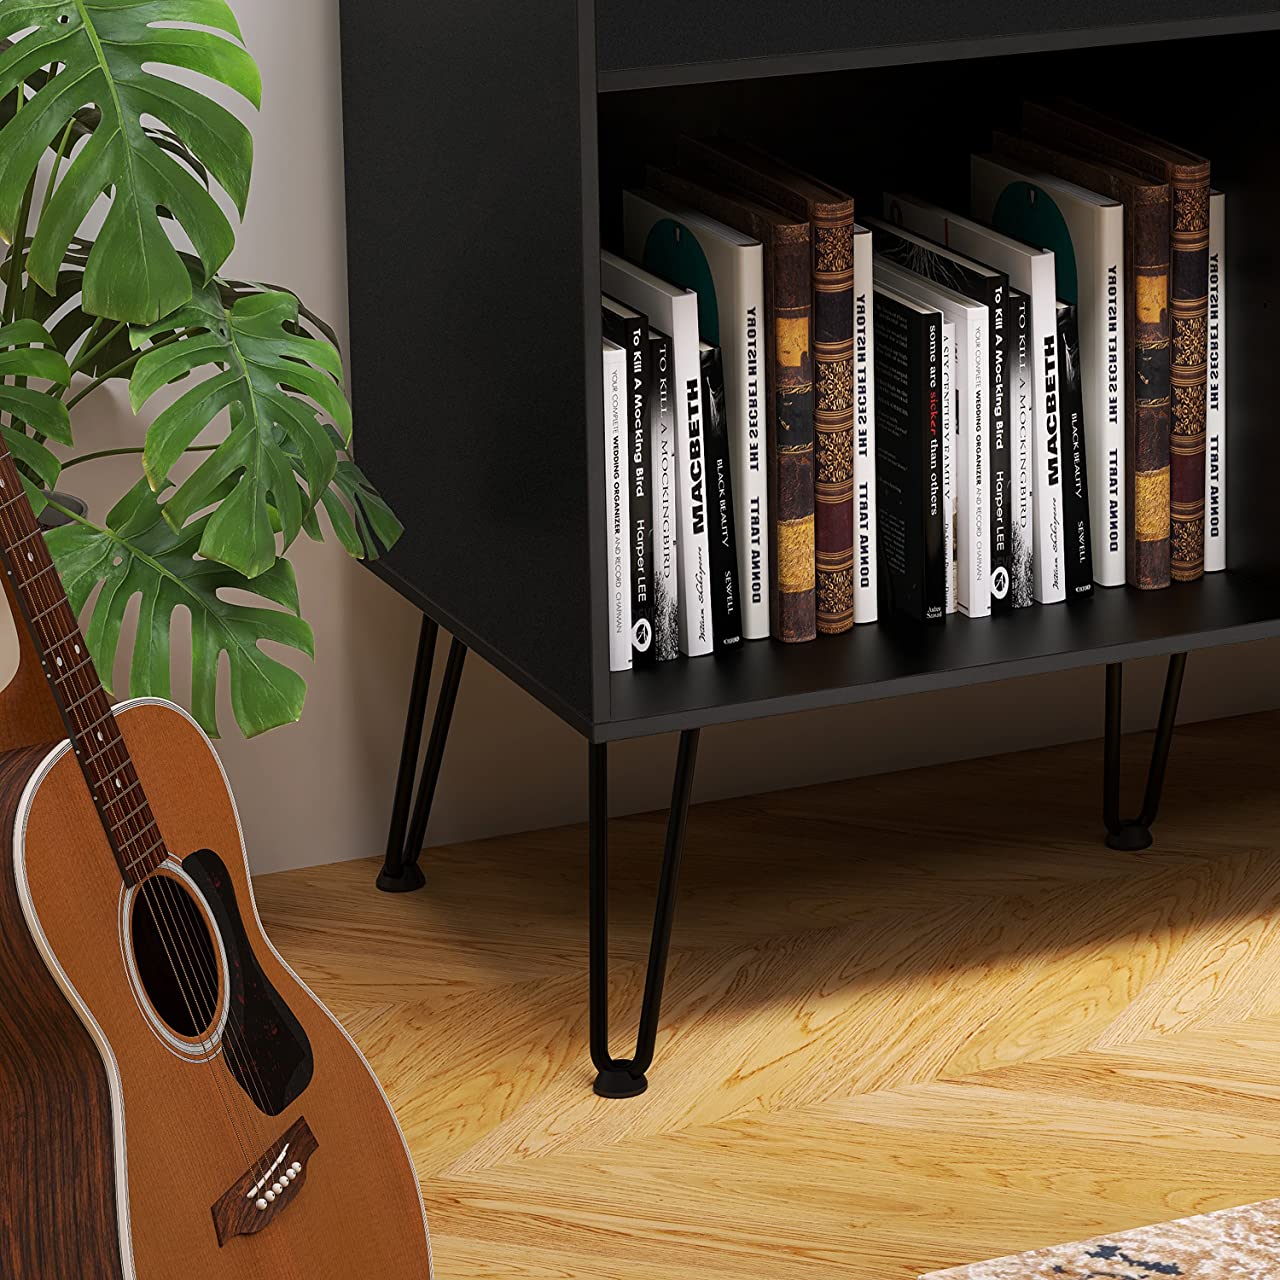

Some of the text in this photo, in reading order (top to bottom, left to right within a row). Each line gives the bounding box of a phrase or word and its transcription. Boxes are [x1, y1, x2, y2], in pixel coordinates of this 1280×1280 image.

[632, 328, 641, 347] To
[633, 350, 642, 373] Kill
[974, 351, 982, 389] COMPLETE
[634, 378, 643, 391] A
[611, 394, 620, 434] COMPLETE
[633, 394, 644, 463] Mocking
[930, 390, 939, 436] sicker
[994, 286, 1005, 552] To Kill A Mocking Bird Harper LEE
[1018, 301, 1028, 529] TO KILL A MOCKINGBIRD
[1043, 335, 1060, 487] MACBETH
[611, 435, 620, 480] WEDDING
[658, 343, 671, 579] TO KILL A MOCKINGBIRD
[685, 378, 705, 536] MACBETH
[930, 439, 939, 471] than
[635, 467, 645, 497] Bird
[930, 473, 939, 517] others
[1071, 412, 1087, 564] BLACK BEAUTY SEWELL
[613, 481, 621, 535] ORGANIZER
[635, 519, 646, 573] Harper
[716, 458, 736, 615] BLACK BEAUTY SEWELL
[615, 591, 623, 634] CHAPMAN
[638, 577, 647, 603] LEE
